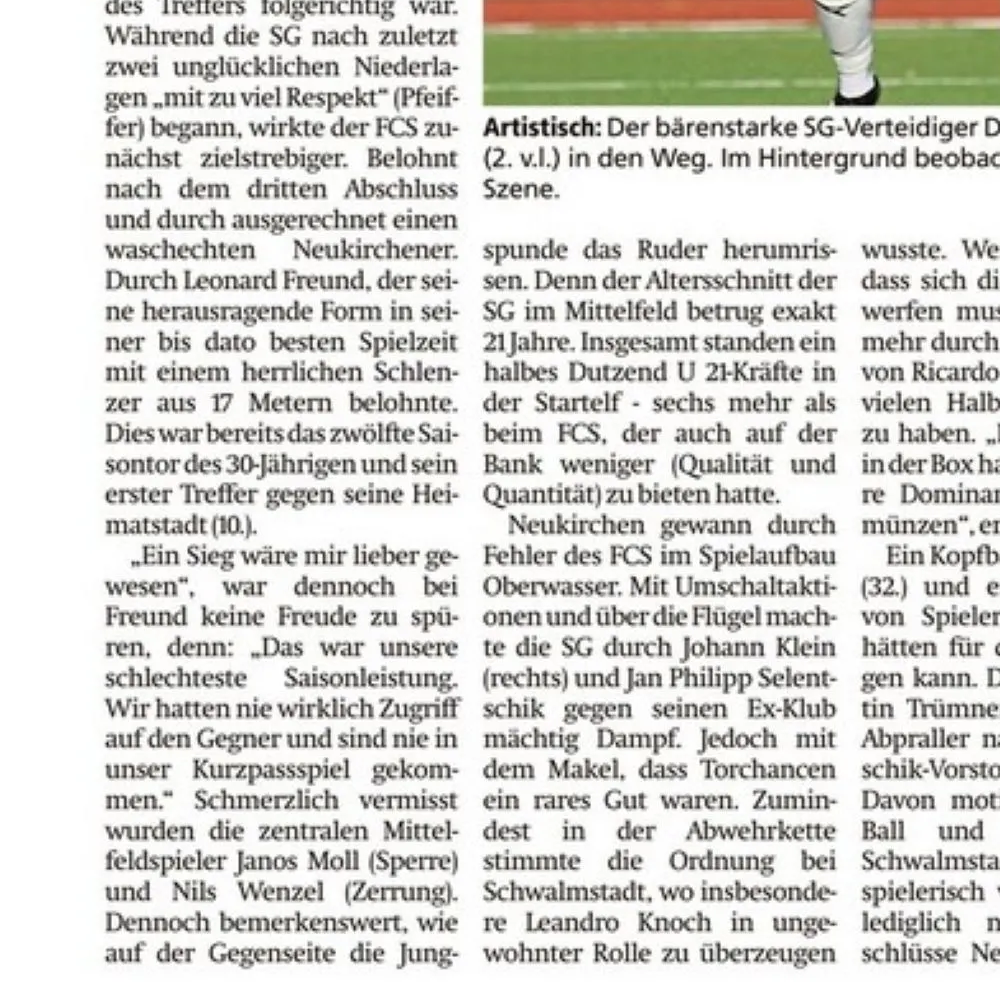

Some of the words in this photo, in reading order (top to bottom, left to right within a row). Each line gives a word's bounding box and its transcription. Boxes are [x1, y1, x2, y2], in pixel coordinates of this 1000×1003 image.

[482, 115, 602, 138] Artistisch:
[607, 116, 650, 138] Der
[655, 115, 798, 138] bärenstarke
[803, 115, 979, 144] SG-Verteidiger
[483, 145, 513, 172] (2.
[519, 146, 561, 172] v.l.)
[568, 146, 591, 168] in
[597, 146, 644, 169] den
[650, 147, 713, 175] Weg.
[721, 147, 751, 168] Im
[758, 146, 907, 175] Hintergrund
[482, 177, 560, 200] Szene.
[104, 238, 256, 260] waschechten
[293, 237, 458, 260] Neukirchener.
[483, 237, 569, 266] spunde
[582, 237, 622, 260] das
[638, 238, 709, 260] Ruder
[723, 237, 837, 260] herumris-
[482, 300, 515, 322] SG
[525, 299, 556, 322] im
[565, 299, 678, 322] Mittelfeld
[686, 300, 764, 327] betrug
[771, 299, 835, 322] exakt
[105, 397, 143, 413] zer
[156, 397, 197, 413] aus
[211, 392, 234, 413] 17
[249, 391, 333, 413] Metern
[349, 390, 458, 414] belohnte.
[861, 390, 932, 413] vielen
[861, 610, 905, 627] von
[105, 666, 248, 688] schlechteste
[284, 666, 459, 694] Saisonleistung.
[484, 726, 580, 755] mächtig
[597, 726, 682, 755] Dampf.
[697, 726, 778, 755] Jedoch
[796, 726, 836, 749] mit
[862, 819, 905, 841] Ball
[938, 819, 984, 841] und
[105, 849, 228, 878] feldspieler
[233, 850, 298, 878] Janos
[307, 849, 360, 871] Moll
[368, 849, 459, 877] (Sperre)
[861, 941, 958, 964] schlüsse
